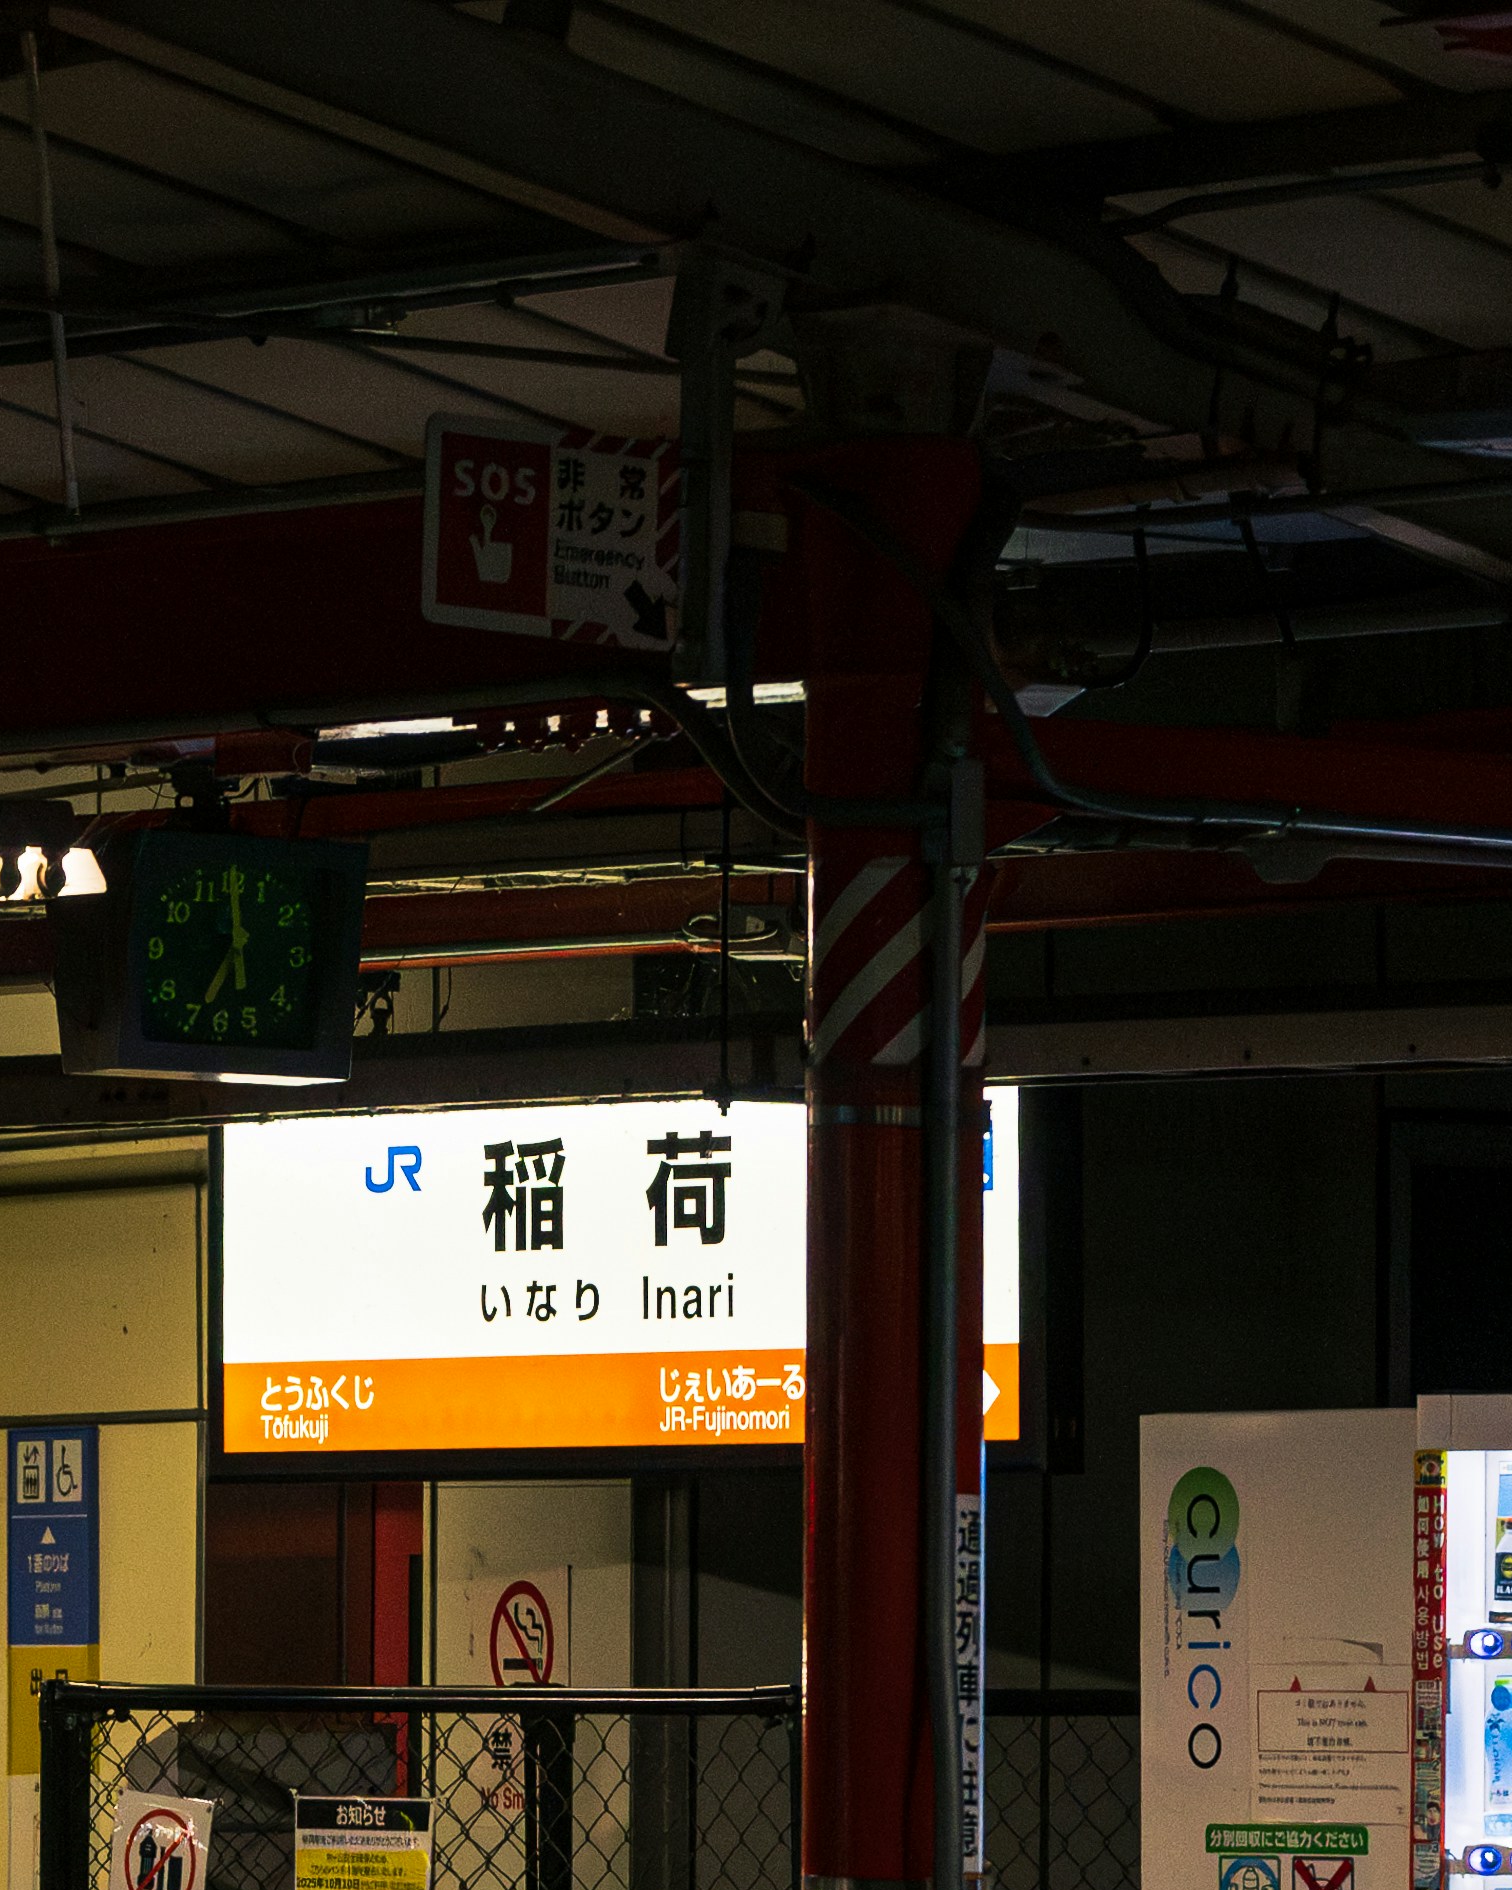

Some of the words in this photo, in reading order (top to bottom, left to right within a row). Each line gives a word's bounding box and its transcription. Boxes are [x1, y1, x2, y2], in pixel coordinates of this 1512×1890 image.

[452, 459, 536, 506] SOS
[557, 457, 646, 499] 非常
[556, 500, 645, 538] ボタン
[554, 539, 644, 570] Emergency
[554, 565, 610, 589] Button
[166, 901, 190, 924] 10
[278, 904, 293, 927] 2
[148, 936, 164, 960] 9
[289, 946, 304, 968] 3
[270, 984, 285, 1007] 4
[185, 1003, 202, 1026] 7
[212, 1009, 229, 1033] 6
[241, 1006, 257, 1029] 5
[365, 1145, 422, 1193] JR
[480, 1129, 734, 1254] 稲荷
[478, 1281, 603, 1325] いなり
[641, 1272, 736, 1323] Inari
[260, 1375, 376, 1414] とうふくじ
[657, 1404, 791, 1437] JR-Fujinomori
[1186, 1494, 1230, 1769] curico
[336, 1804, 387, 1827] お知らせ
[1210, 1830, 1364, 1849] 分別回収にご協力ください
